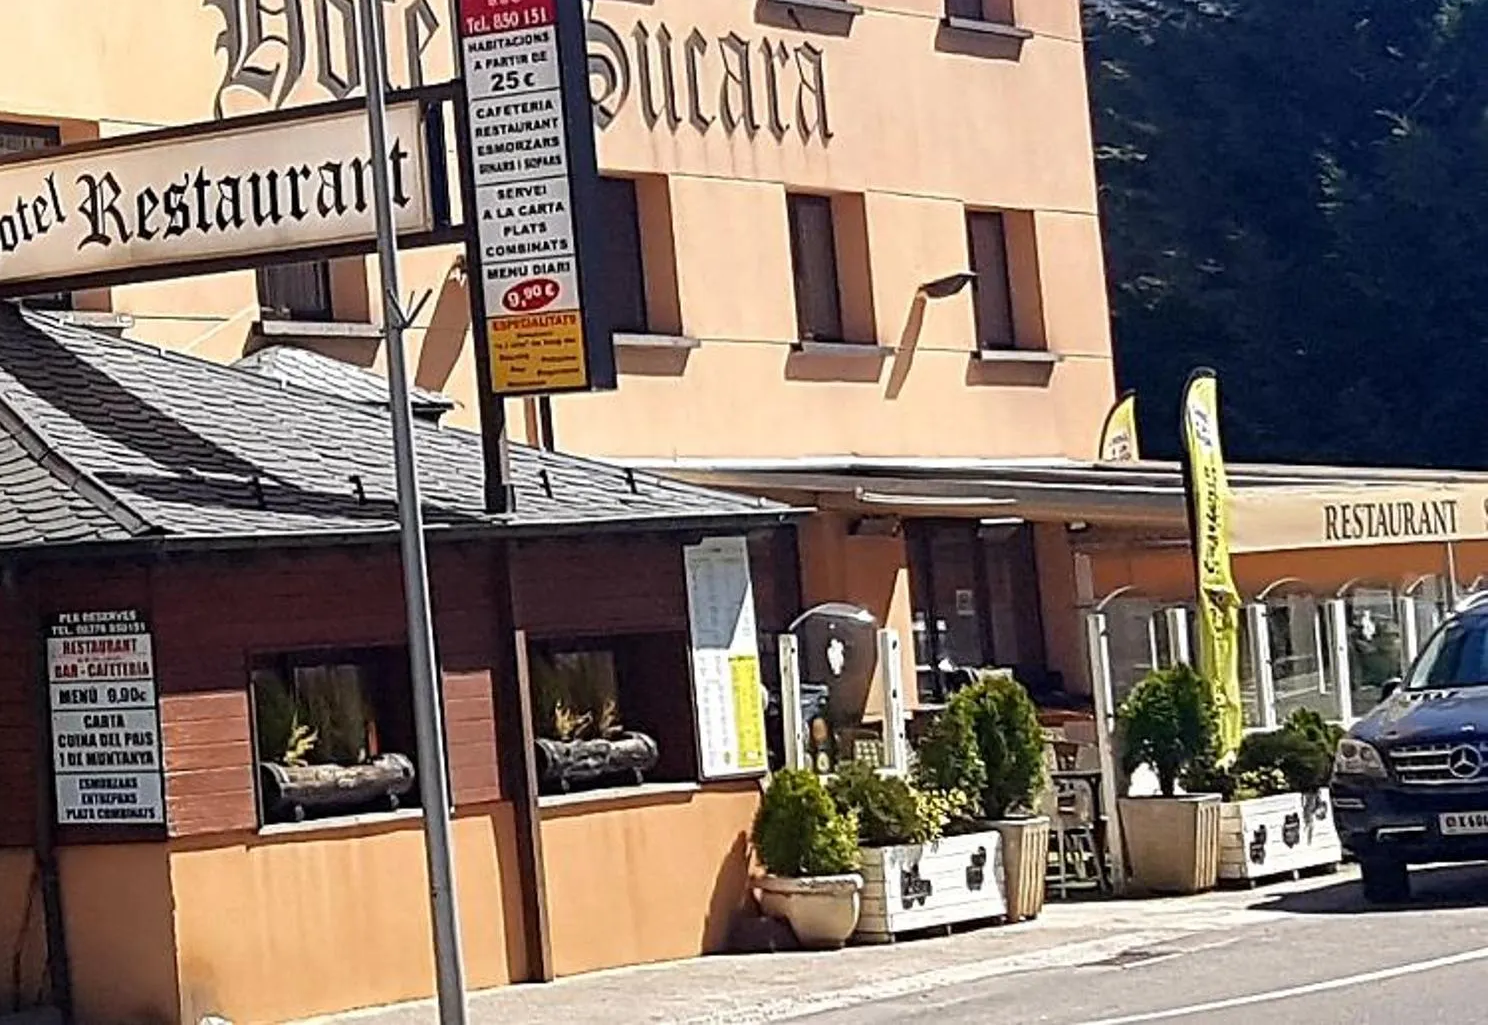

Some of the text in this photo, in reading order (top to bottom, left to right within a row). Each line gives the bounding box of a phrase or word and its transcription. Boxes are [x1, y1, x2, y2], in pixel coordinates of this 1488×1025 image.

[466, 15, 491, 34] Tel.
[524, 7, 547, 25] 151
[468, 31, 549, 52] HABITACIONS
[474, 60, 482, 71] A
[485, 54, 528, 69] PARTIR
[491, 70, 519, 91] 25
[476, 99, 553, 119] CAFETERIA
[475, 117, 558, 138] RESTAURANT
[477, 136, 560, 156] ESMORZARS
[77, 136, 412, 251] Restaurant
[497, 185, 547, 200] SERVEI
[482, 201, 565, 221] A LA CARTA
[503, 223, 547, 237] PLATS
[485, 240, 569, 258] COMBINATS
[533, 261, 570, 275] DIARI
[1324, 499, 1457, 541] RESTAURANT
[63, 638, 137, 654] RESTAURANT
[83, 714, 126, 729] CARTA
[58, 733, 98, 748] CUINA
[99, 732, 122, 747] DEL
[68, 752, 83, 766] DE
[86, 750, 154, 766] MUNTANYA
